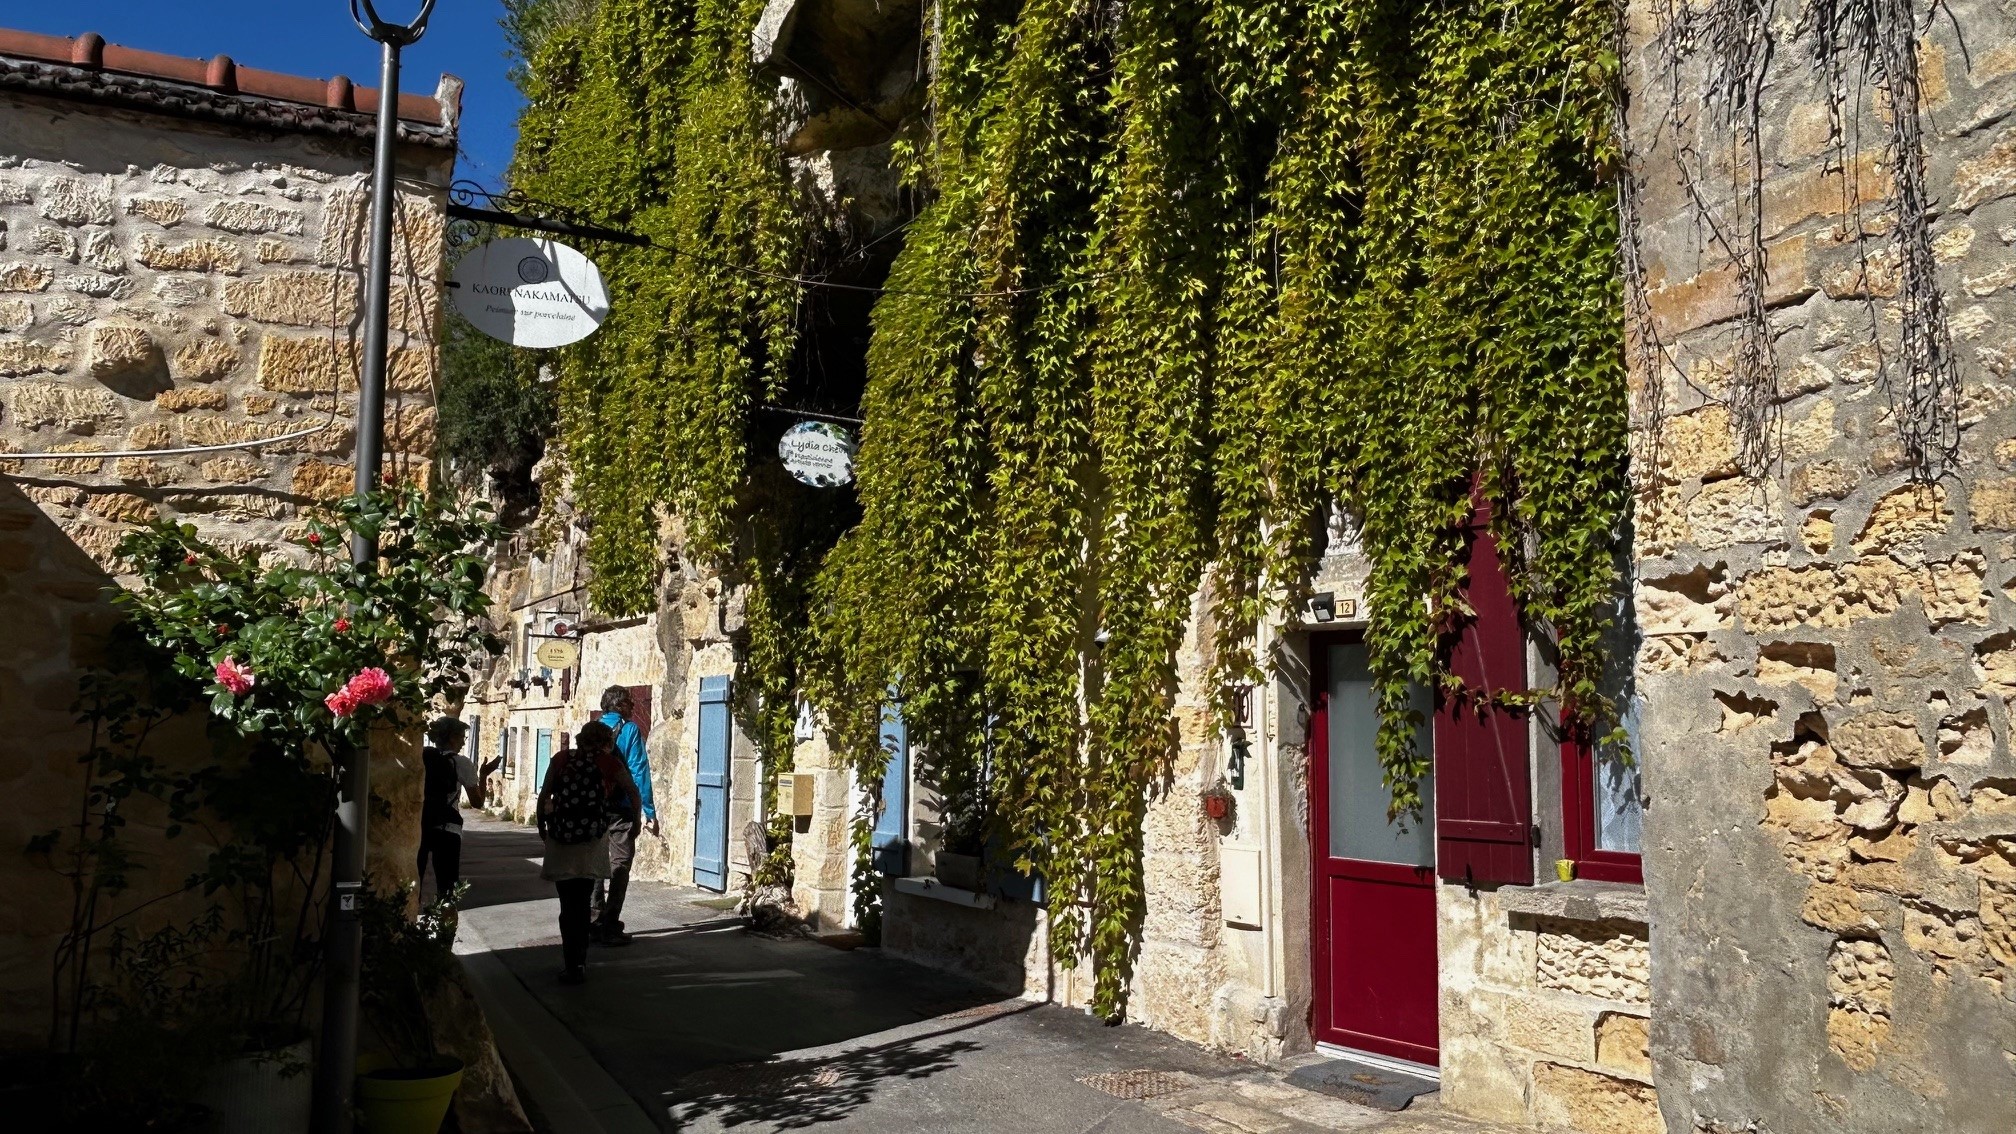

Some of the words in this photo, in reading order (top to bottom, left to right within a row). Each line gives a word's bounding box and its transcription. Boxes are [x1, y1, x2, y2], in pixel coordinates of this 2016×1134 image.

[472, 283, 512, 297] KAORI
[520, 309, 533, 317] sur
[791, 440, 820, 453] Lydia
[1340, 602, 1350, 614] 12
